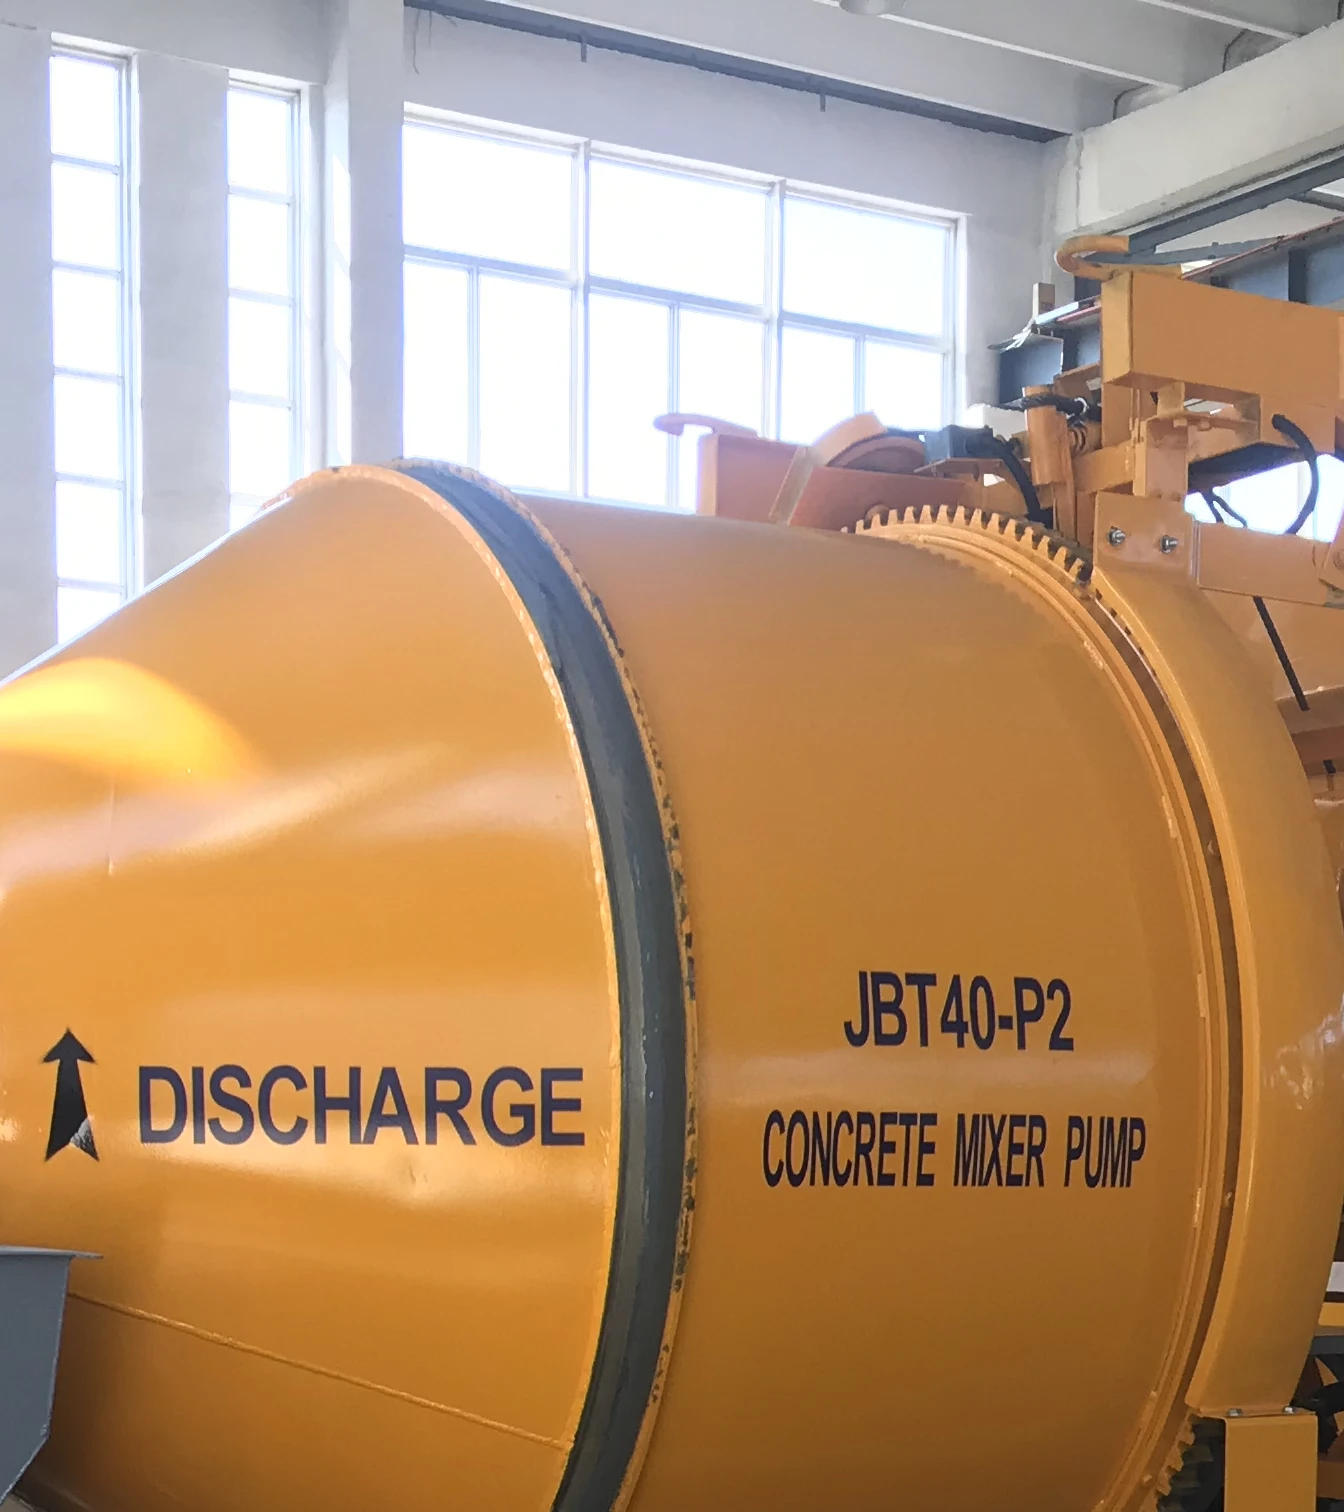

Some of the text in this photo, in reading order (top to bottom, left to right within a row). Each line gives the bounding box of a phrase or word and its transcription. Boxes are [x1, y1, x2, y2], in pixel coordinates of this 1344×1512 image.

[844, 970, 1075, 1052] JBT40-P2
[138, 1064, 585, 1147] DISCHARGE
[762, 1109, 1147, 1189] CONCRETE MIXER PUMP
